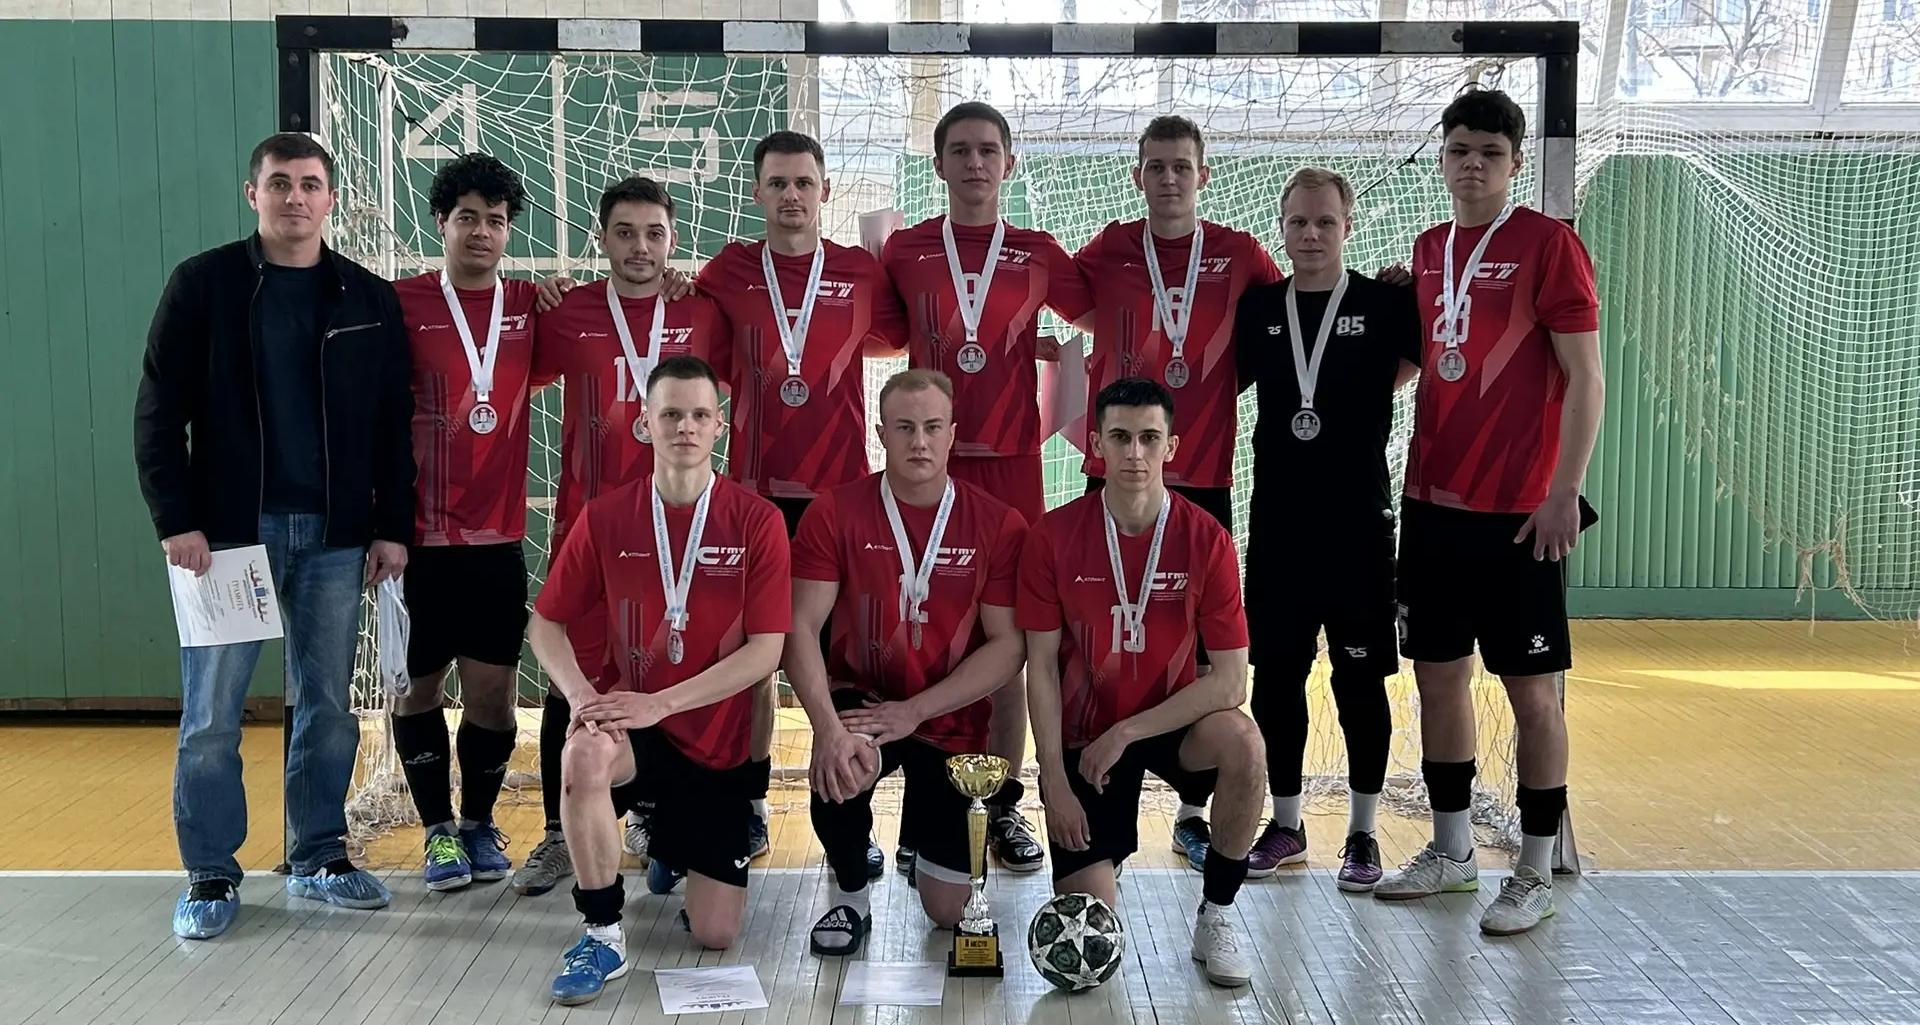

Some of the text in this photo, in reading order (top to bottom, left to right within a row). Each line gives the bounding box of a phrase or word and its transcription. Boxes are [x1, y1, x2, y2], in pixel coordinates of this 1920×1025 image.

[637, 91, 719, 182] 5
[1336, 315, 1365, 336] 85
[1432, 294, 1472, 343] 23
